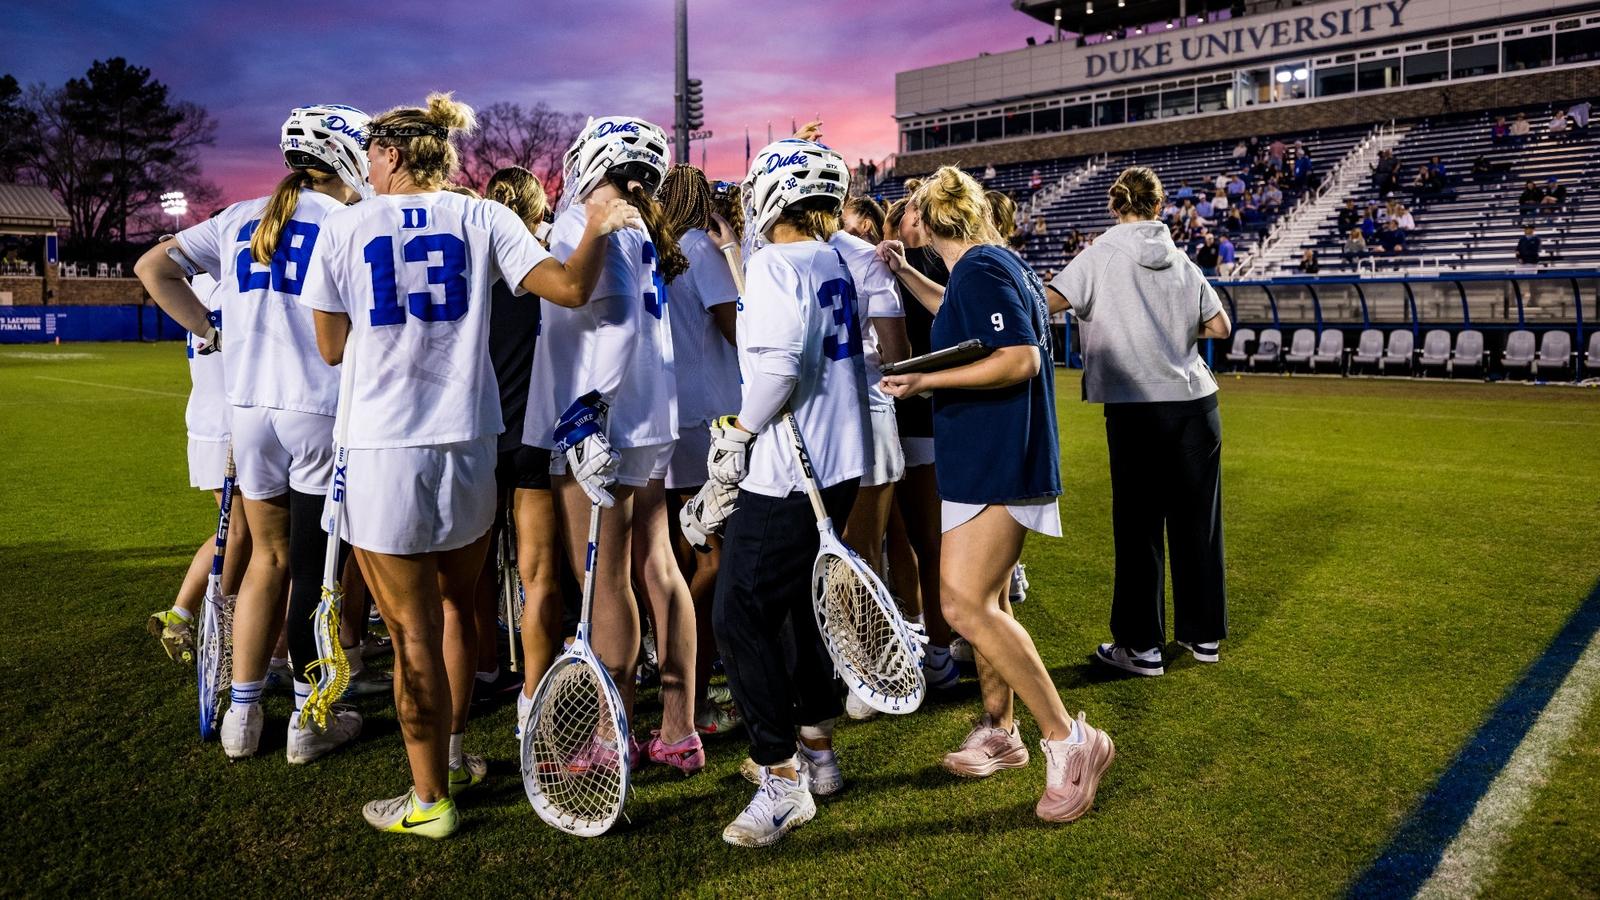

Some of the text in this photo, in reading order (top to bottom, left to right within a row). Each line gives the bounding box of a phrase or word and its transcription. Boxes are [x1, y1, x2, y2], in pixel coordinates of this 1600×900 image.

[1085, 0, 1408, 79] DUKE UNIVERSITY
[326, 115, 367, 146] Duke
[597, 121, 639, 138] Duke
[766, 150, 808, 174] Duke
[785, 177, 798, 190] 32
[400, 207, 429, 230] D
[363, 233, 469, 327] 13
[990, 312, 1005, 332] 9
[574, 413, 594, 427] DUKE
[795, 444, 813, 479] STX
[333, 464, 347, 504] STX
[218, 509, 232, 540] STX
